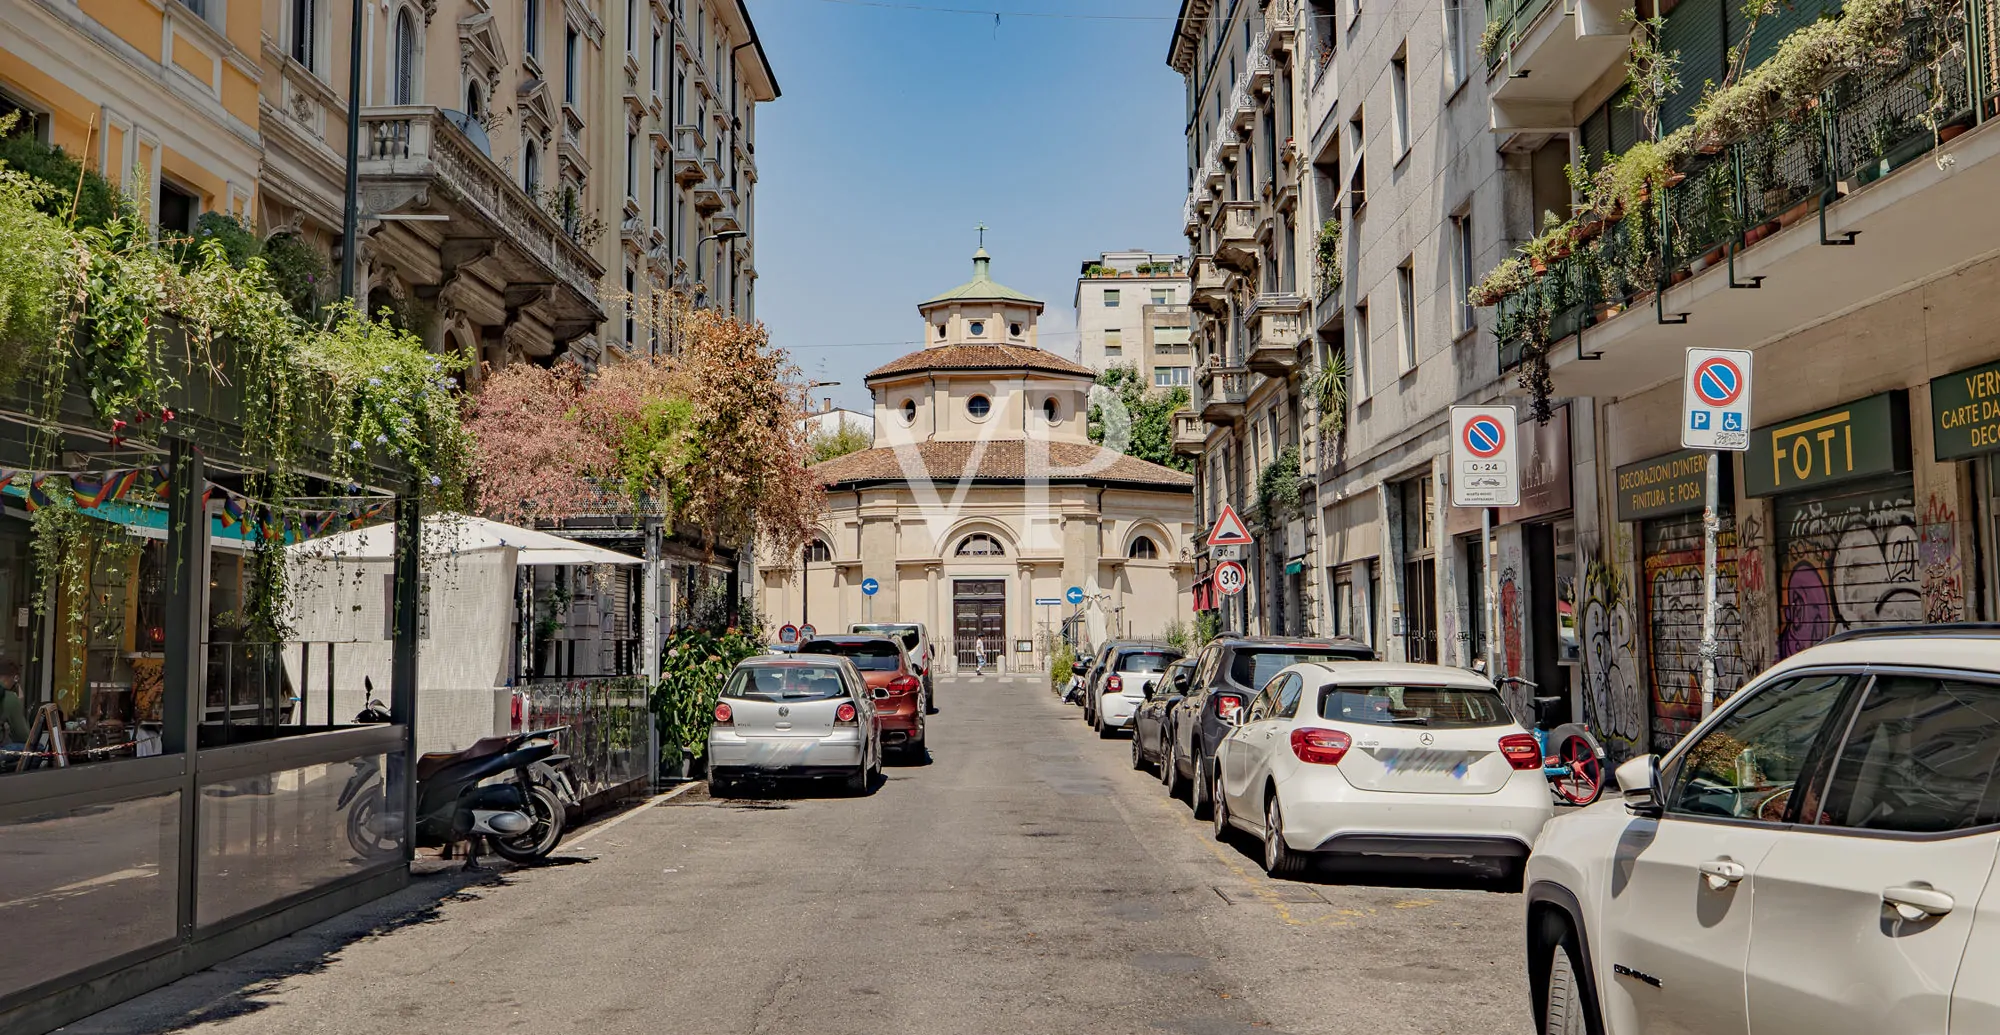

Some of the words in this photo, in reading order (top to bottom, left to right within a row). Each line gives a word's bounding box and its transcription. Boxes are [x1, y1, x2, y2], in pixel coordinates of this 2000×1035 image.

[1694, 412, 1707, 428] P
[1941, 404, 1980, 429] CARTE
[1772, 410, 1853, 486] FOTI
[1971, 424, 2000, 447] DEC
[1620, 461, 1671, 491] DECORAZIONI
[1672, 453, 1708, 478] D'INTERN
[1632, 489, 1666, 511] FINITURA
[1669, 486, 1675, 503] E
[1678, 481, 1701, 502] POSA
[1222, 570, 1238, 585] 30
